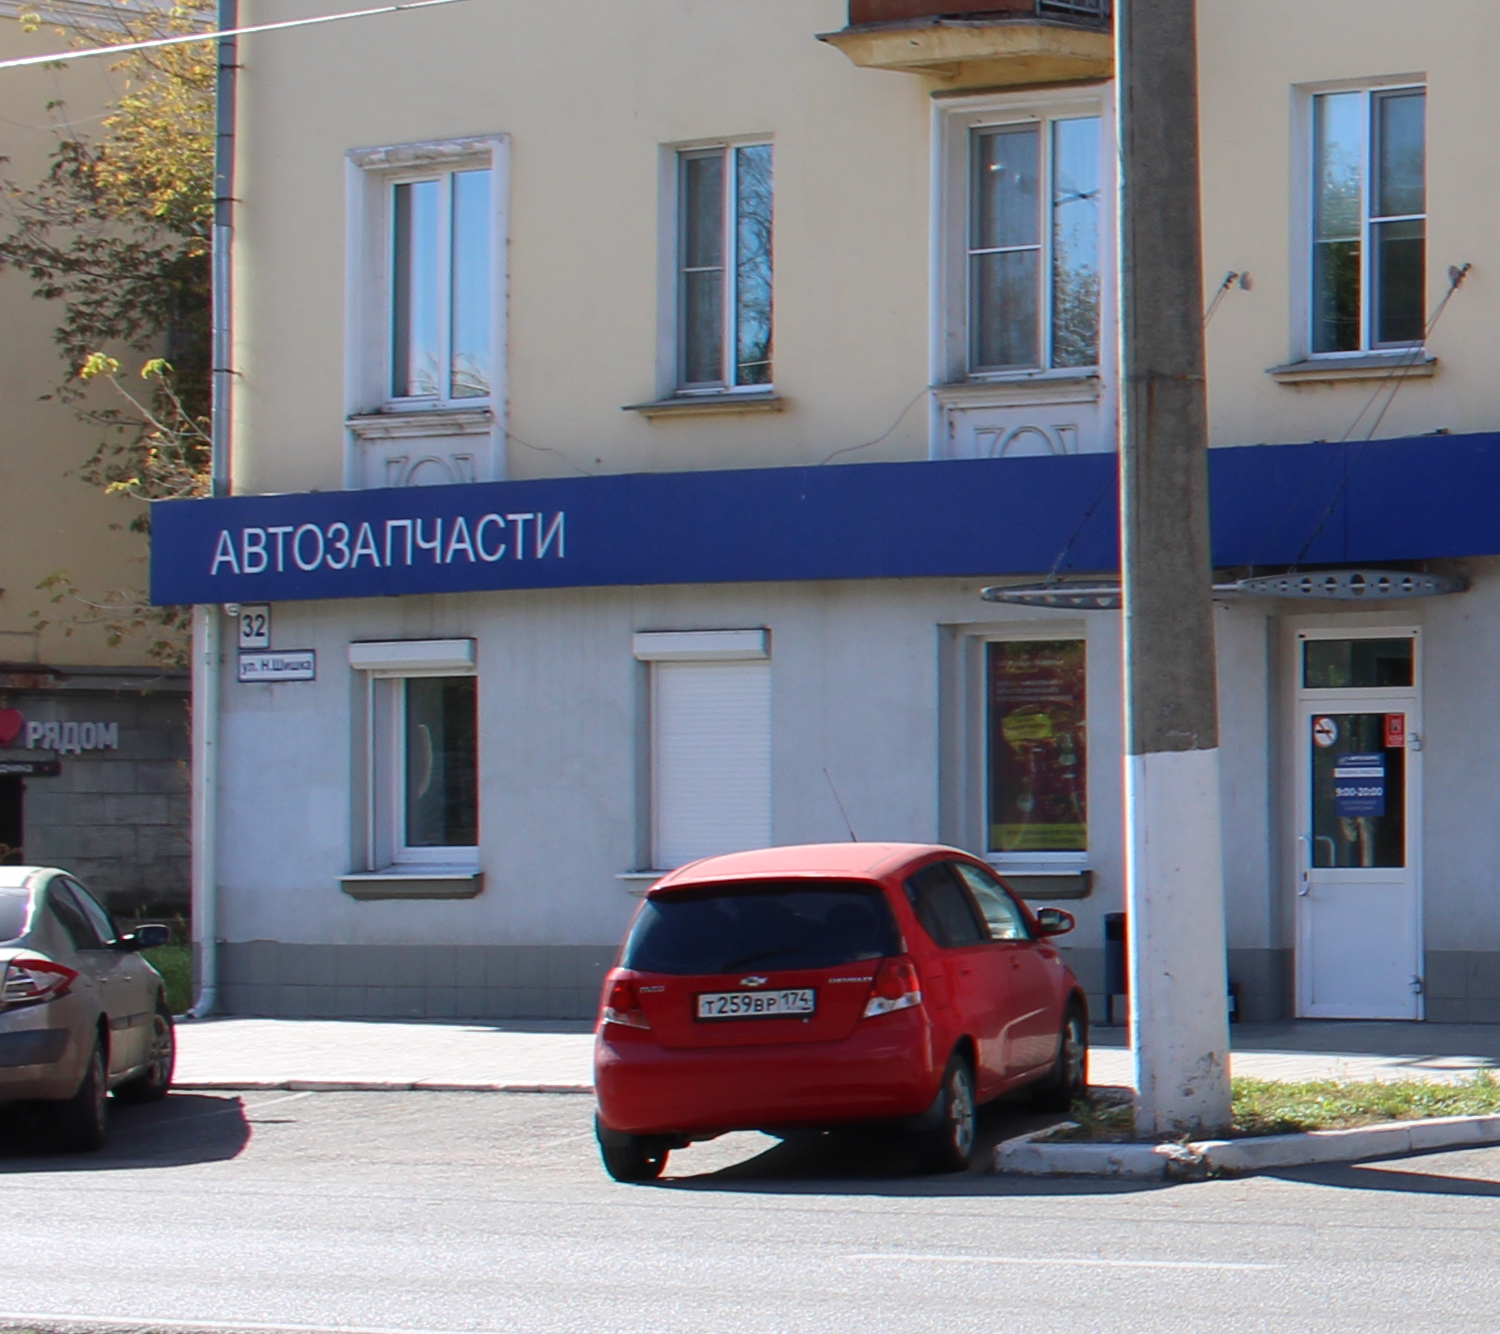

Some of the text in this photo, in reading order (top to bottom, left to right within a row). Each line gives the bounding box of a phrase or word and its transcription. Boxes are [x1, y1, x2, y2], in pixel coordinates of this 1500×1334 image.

[210, 511, 565, 576] АВТОЗАПЧАСТИ
[242, 613, 266, 638] 32
[25, 720, 119, 755] РЯДОМ
[704, 991, 811, 1014] Т259ВР 174
